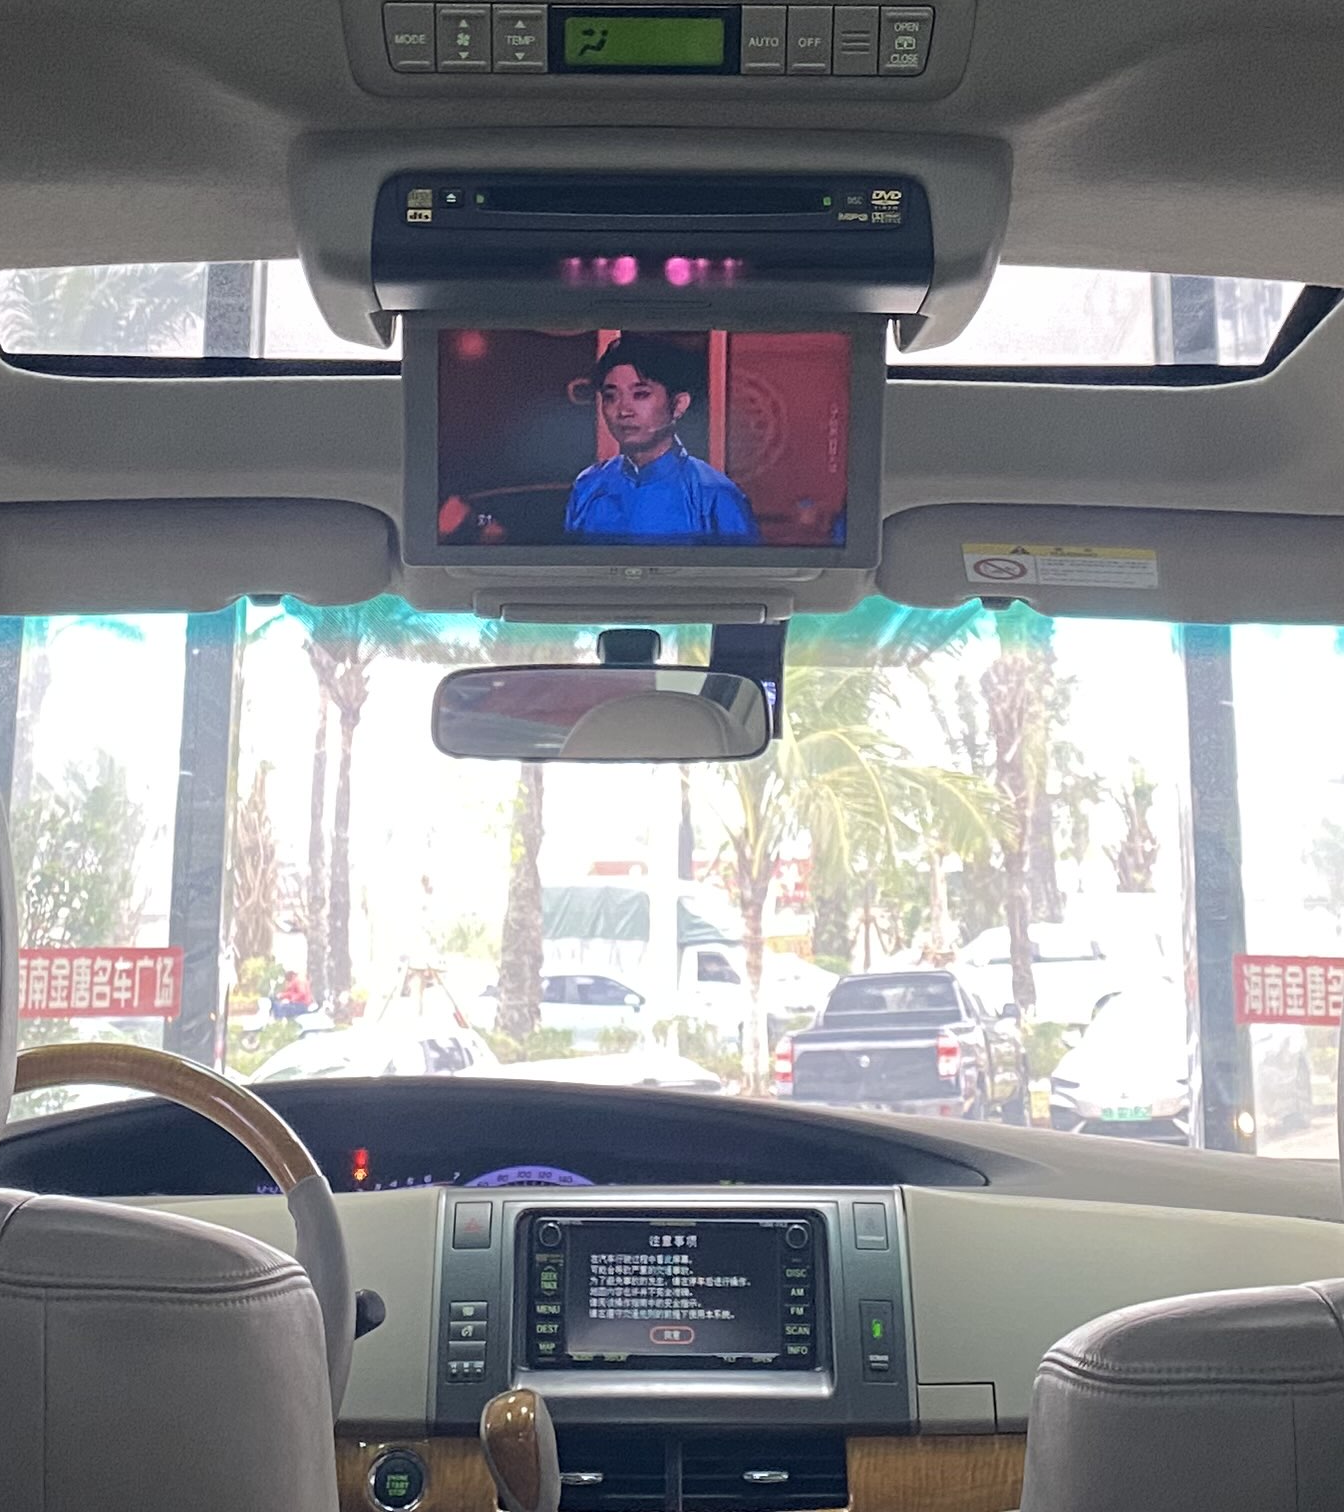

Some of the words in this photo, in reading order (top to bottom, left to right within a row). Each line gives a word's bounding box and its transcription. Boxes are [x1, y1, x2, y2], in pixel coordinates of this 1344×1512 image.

[894, 22, 919, 32] OPEN
[394, 34, 427, 45] MODE
[506, 35, 536, 46] TEMP
[748, 38, 779, 48] AUTO
[798, 38, 822, 48] OFF
[889, 54, 919, 65] CLOSE
[872, 190, 902, 200] DVD
[786, 1269, 807, 1278] DISC
[791, 1288, 804, 1296] AM
[536, 1305, 560, 1314] MENU
[790, 1307, 804, 1315] FM
[536, 1324, 559, 1333] DEST
[785, 1326, 810, 1335] SCAN
[787, 1346, 808, 1354] INFO
